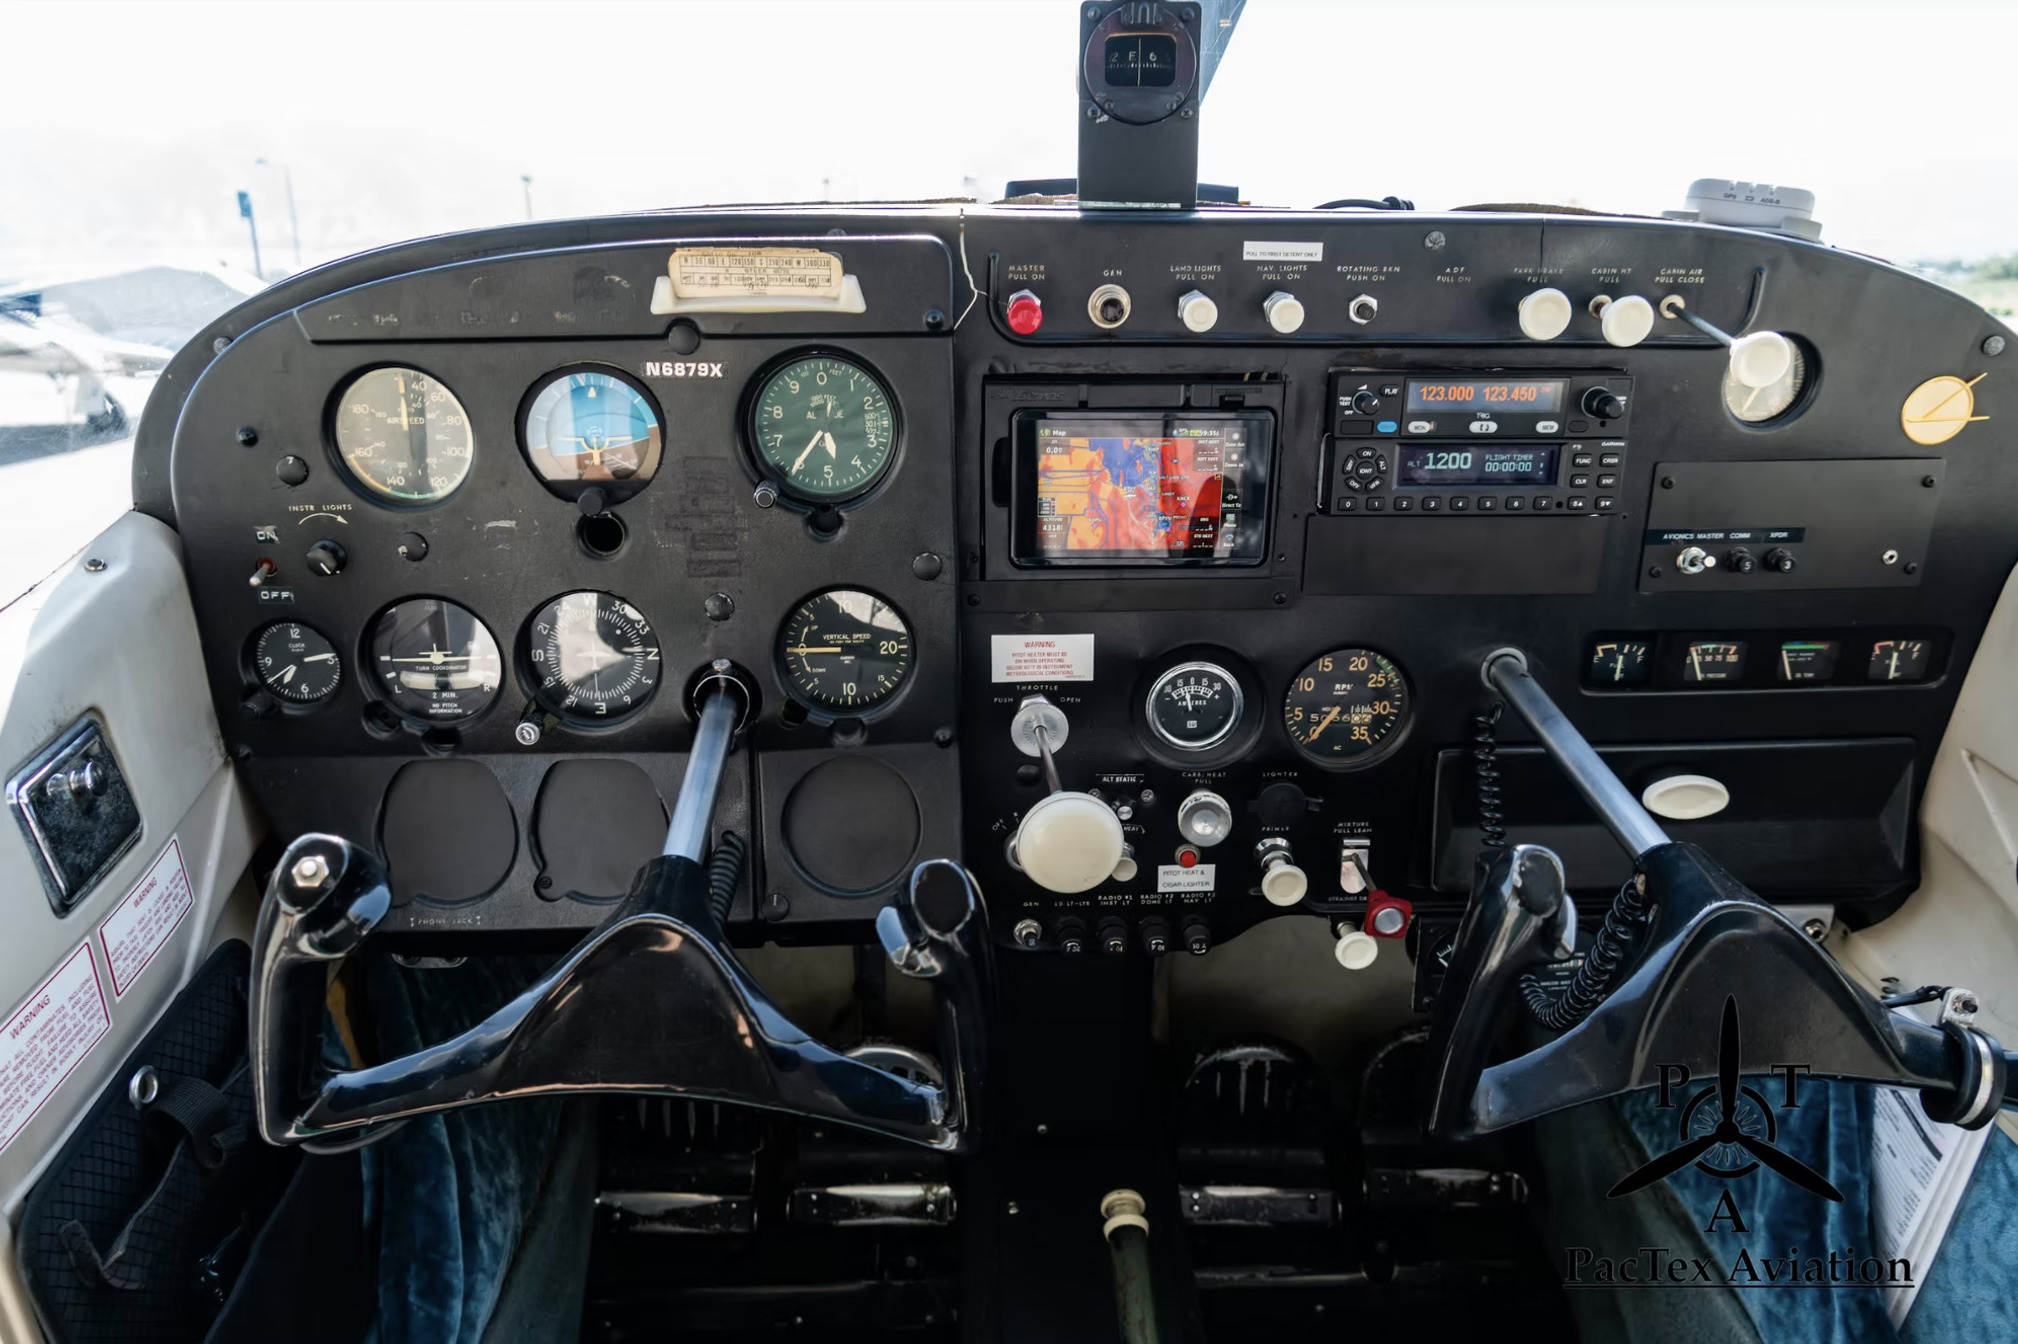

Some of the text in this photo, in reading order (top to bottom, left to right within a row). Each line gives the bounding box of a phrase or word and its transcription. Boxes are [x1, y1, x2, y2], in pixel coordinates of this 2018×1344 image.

[1129, 52, 1156, 62] E 6
[646, 362, 722, 377] N6879X
[816, 372, 827, 385] 0
[412, 382, 427, 390] 40
[789, 381, 799, 394] 9
[430, 392, 446, 402] 60
[1420, 386, 1537, 402] 123.000 123.450
[863, 396, 874, 410] 2
[773, 406, 783, 419] 8
[447, 416, 462, 425] 80
[773, 434, 783, 448] 7
[867, 434, 877, 448] 3
[355, 448, 372, 457] 160
[447, 447, 465, 456] 100
[851, 455, 862, 467] 4
[1424, 453, 1472, 469] 1200
[1485, 462, 1532, 472] 00:00:00
[824, 465, 834, 478] 5
[386, 476, 405, 485] 140
[430, 477, 448, 486] 120
[261, 591, 290, 599] OFF
[583, 593, 597, 606] W
[612, 601, 627, 614] 30
[839, 600, 852, 614] 10
[290, 628, 300, 639] 12
[537, 622, 550, 635] 21
[634, 620, 650, 635] 33
[646, 648, 660, 660] N
[880, 641, 898, 655] 20
[265, 657, 272, 666] 9
[531, 649, 544, 662] S
[1318, 658, 1333, 672] 15
[1349, 657, 1368, 671] 20
[1213, 682, 1221, 690] 30
[1299, 678, 1314, 691] 10
[1368, 674, 1386, 687] 25
[301, 683, 309, 693] 6
[843, 682, 857, 696] 10
[594, 702, 606, 714] E
[1294, 708, 1302, 721] 5
[1372, 701, 1389, 715] 30
[1351, 726, 1368, 740] 35
[133, 877, 158, 908] WARNING
[10, 994, 50, 1040] WARNING
